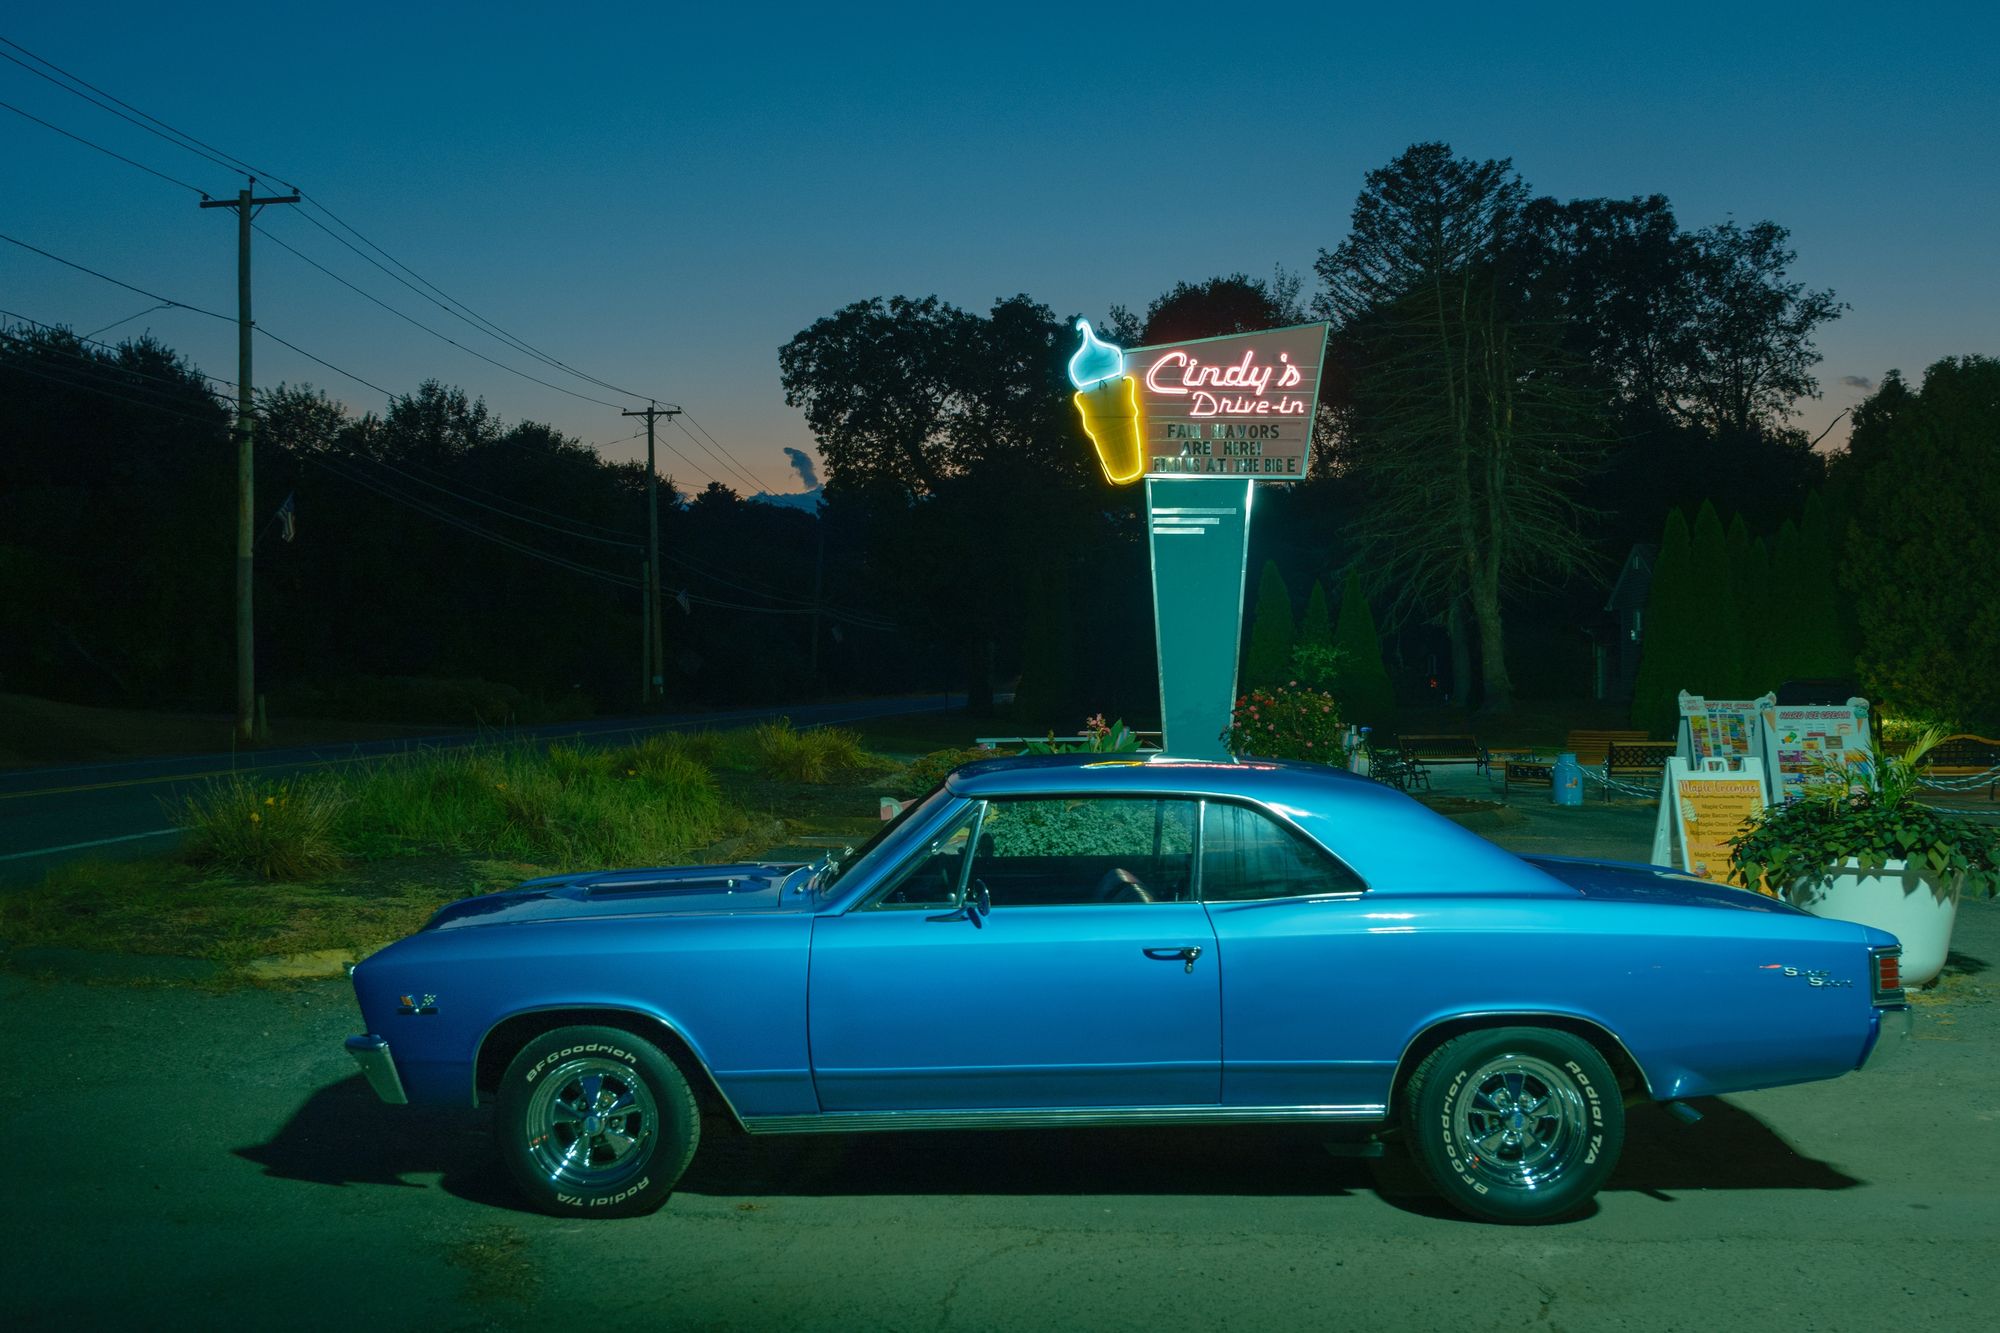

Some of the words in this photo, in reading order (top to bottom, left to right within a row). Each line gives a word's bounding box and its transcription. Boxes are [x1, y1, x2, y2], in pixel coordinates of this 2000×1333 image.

[1145, 350, 1302, 396] Cindy's
[1189, 391, 1305, 417] Drive-in
[1211, 424, 1280, 439] AVORS
[1182, 441, 1211, 455] ARE
[1224, 441, 1262, 455] HERE!
[1206, 458, 1226, 472] AT
[1234, 458, 1259, 472] THE
[1265, 459, 1283, 472] BIG
[1287, 459, 1296, 472] E
[1819, 711, 1851, 719] CREAM
[1679, 780, 1712, 796] Maple
[526, 1043, 638, 1083] BFGoodrich
[1564, 1060, 1603, 1127] Radial
[1584, 1134, 1603, 1165] T/A
[1440, 1069, 1489, 1196] BFGoodrich
[556, 1192, 584, 1207] T/A
[590, 1175, 650, 1207] Radial
